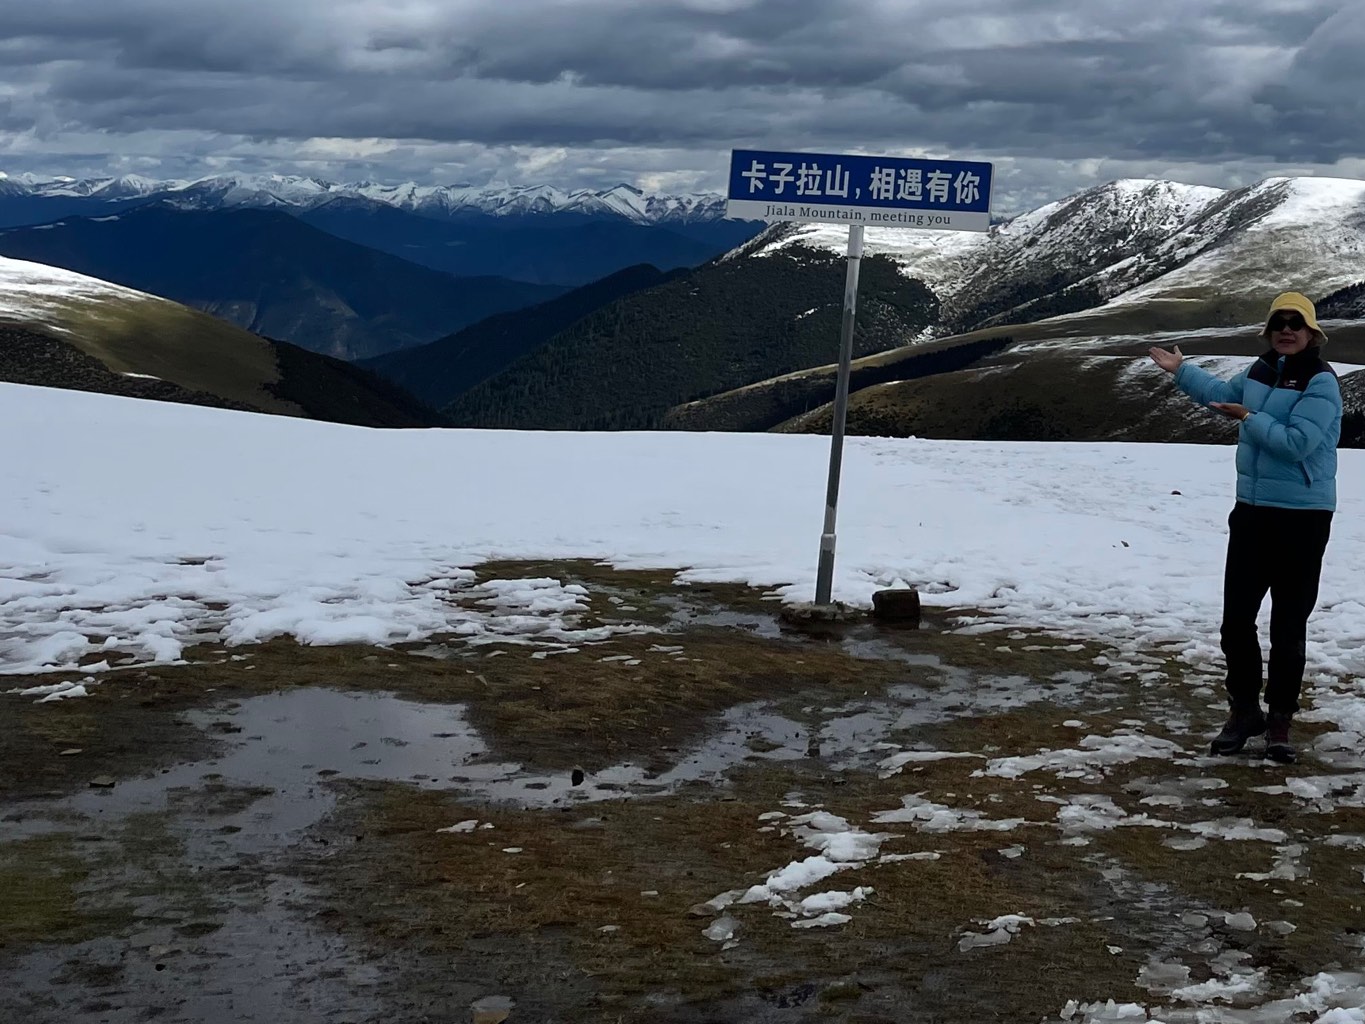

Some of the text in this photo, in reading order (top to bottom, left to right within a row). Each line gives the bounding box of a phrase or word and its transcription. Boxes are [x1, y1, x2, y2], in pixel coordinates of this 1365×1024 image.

[764, 205, 951, 227] Jiala Mountain, meeting you
